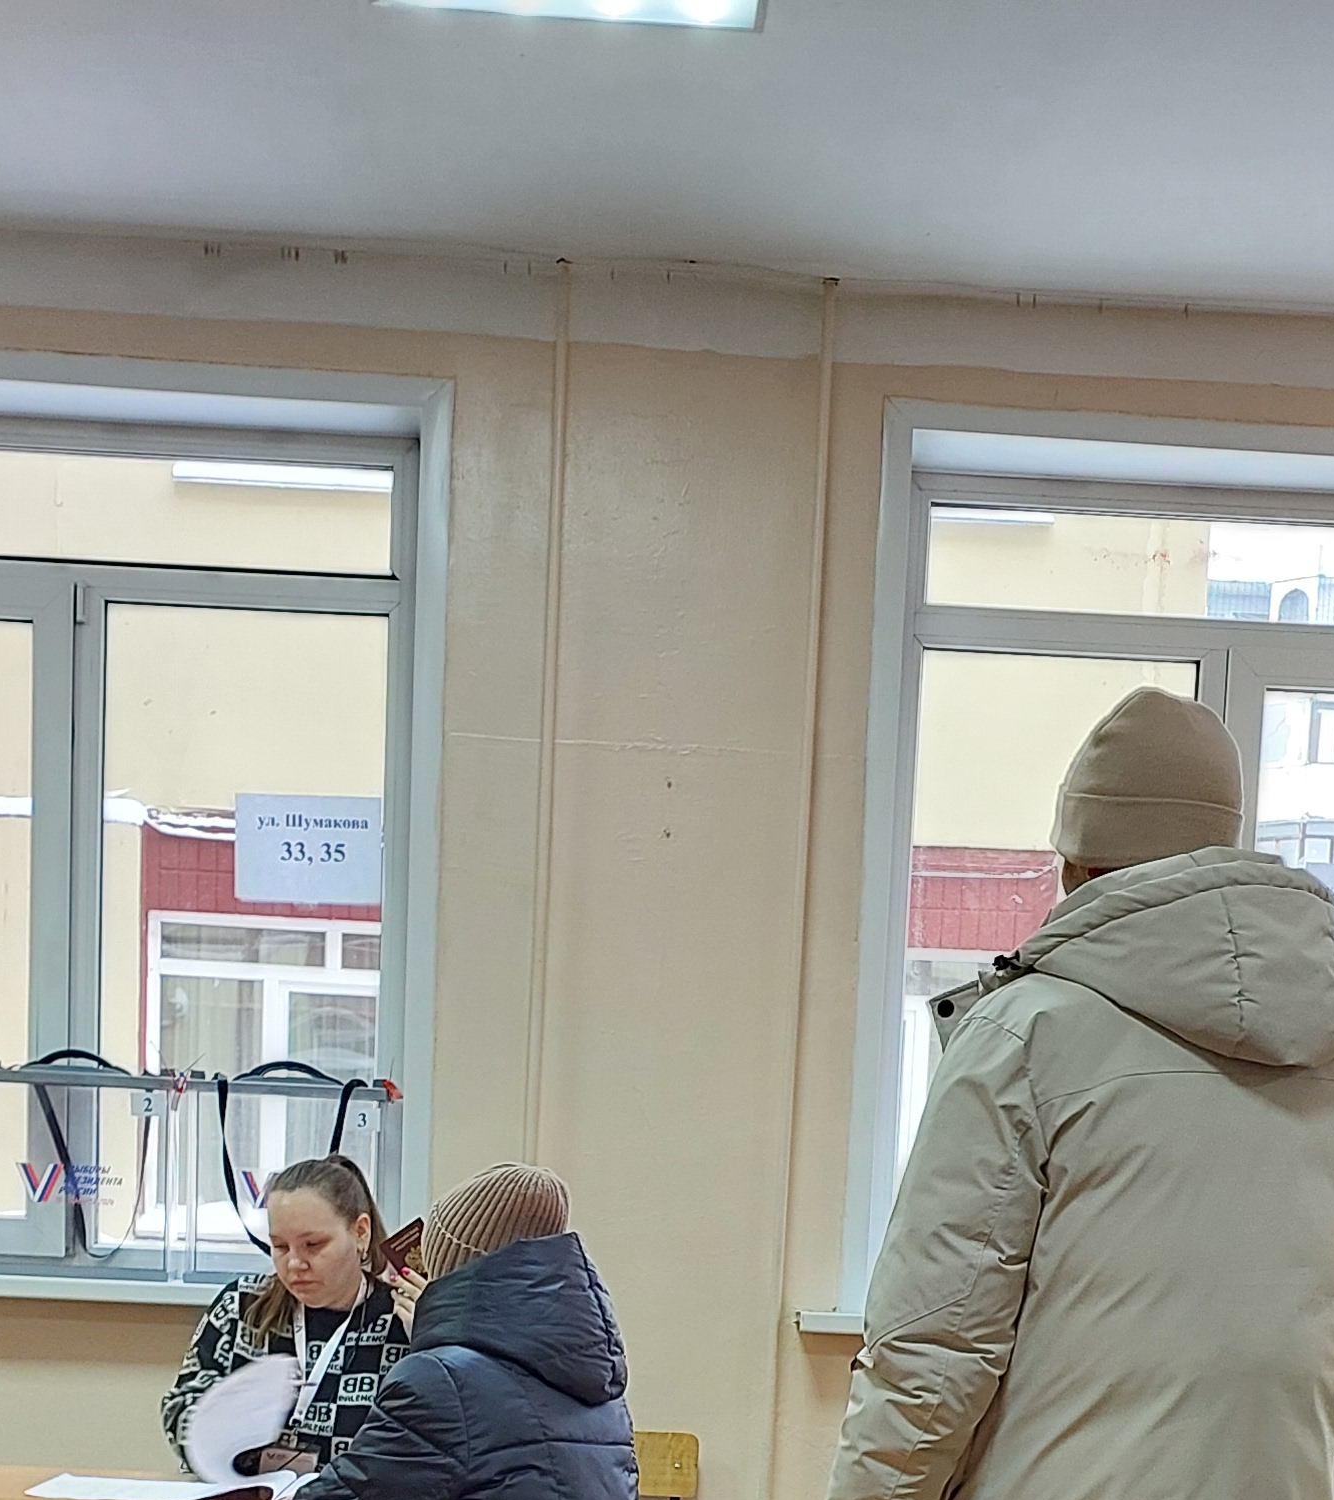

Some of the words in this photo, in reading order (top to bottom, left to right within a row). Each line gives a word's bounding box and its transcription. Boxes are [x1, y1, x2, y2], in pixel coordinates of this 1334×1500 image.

[256, 815, 281, 831] ул.
[285, 813, 370, 832] Шумакова
[279, 841, 314, 866] 33,
[319, 842, 347, 863] 35
[143, 1097, 154, 1113] 2
[357, 1112, 367, 1128] 3
